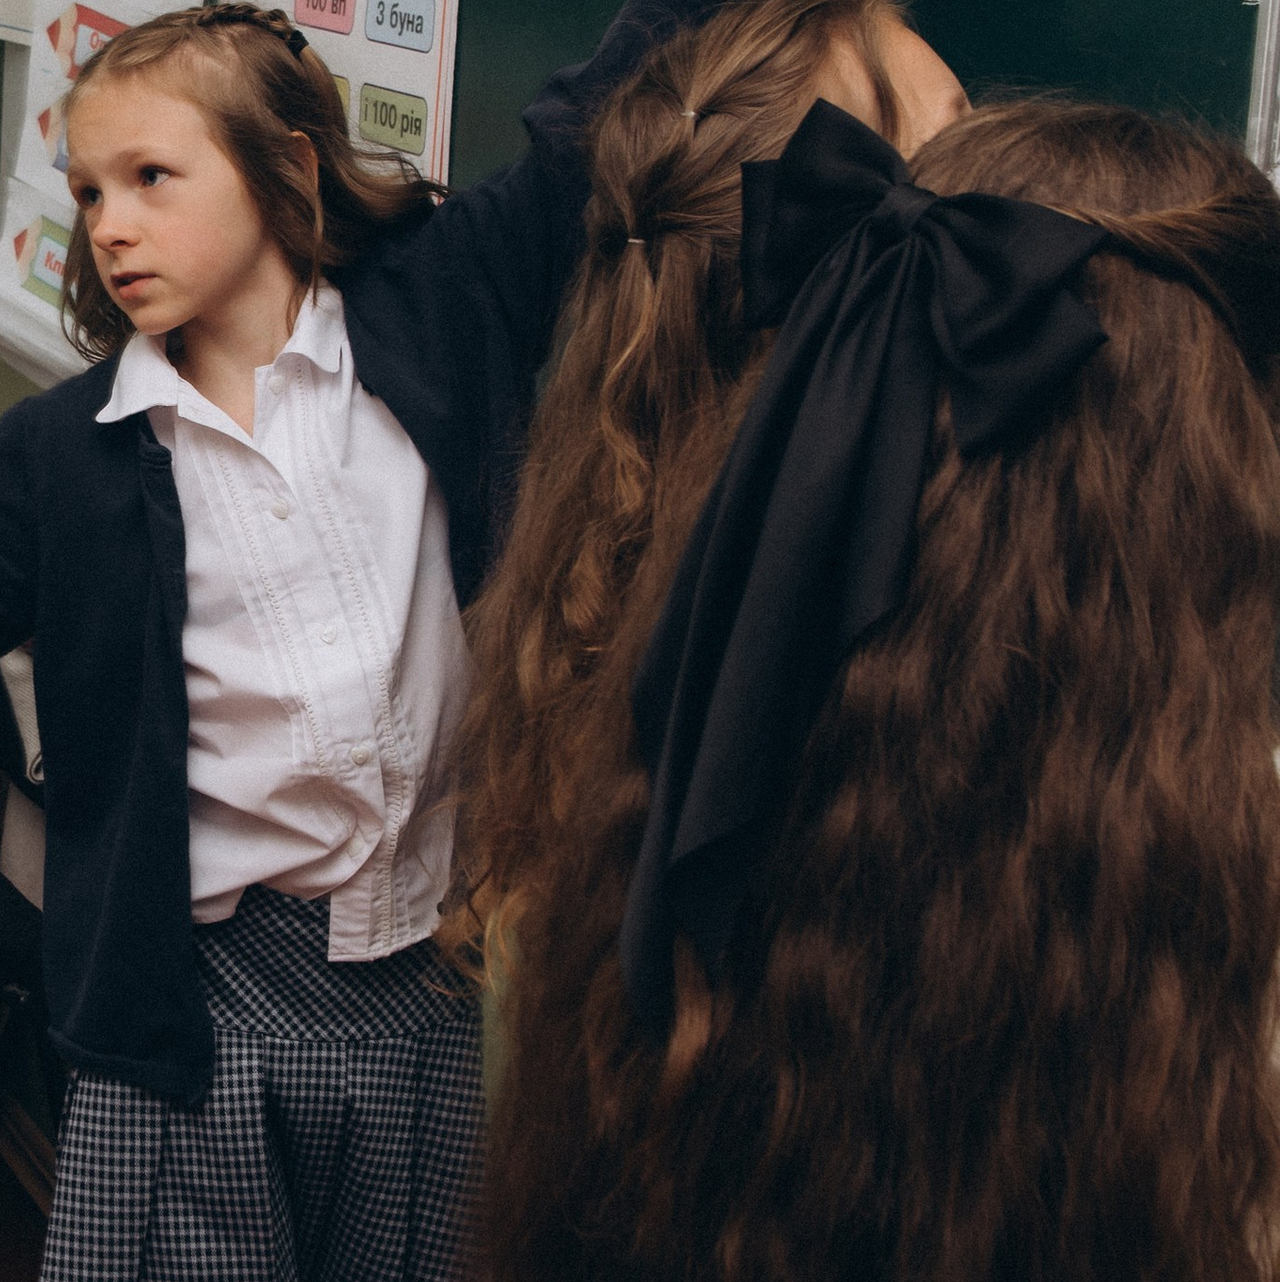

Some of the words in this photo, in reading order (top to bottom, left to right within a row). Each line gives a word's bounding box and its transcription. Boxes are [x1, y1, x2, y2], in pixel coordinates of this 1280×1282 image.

[389, 3, 424, 36] буна
[373, 100, 397, 129] 100
[401, 109, 422, 138] рія
